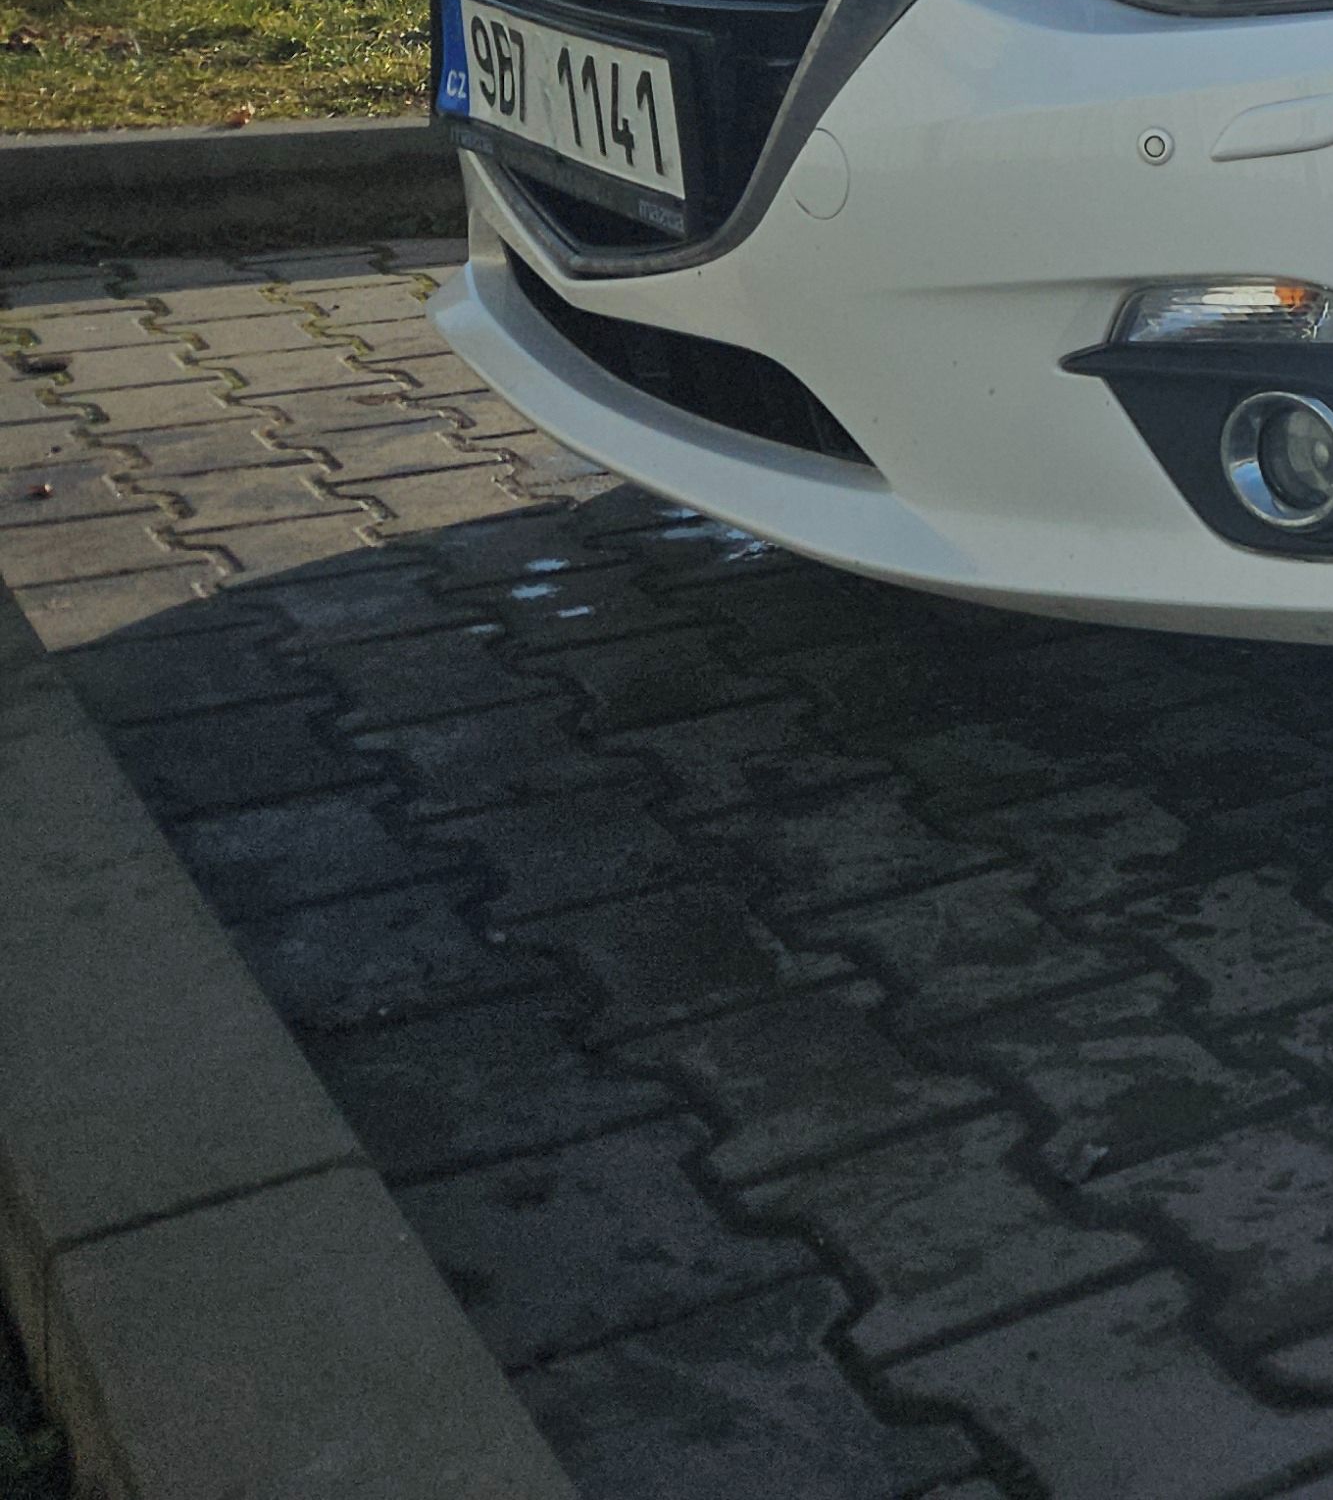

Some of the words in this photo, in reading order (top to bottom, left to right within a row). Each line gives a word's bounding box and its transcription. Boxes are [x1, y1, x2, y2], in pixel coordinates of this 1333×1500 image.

[446, 69, 467, 99] CZ
[470, 15, 525, 124] 9B7
[557, 46, 665, 176] 1141
